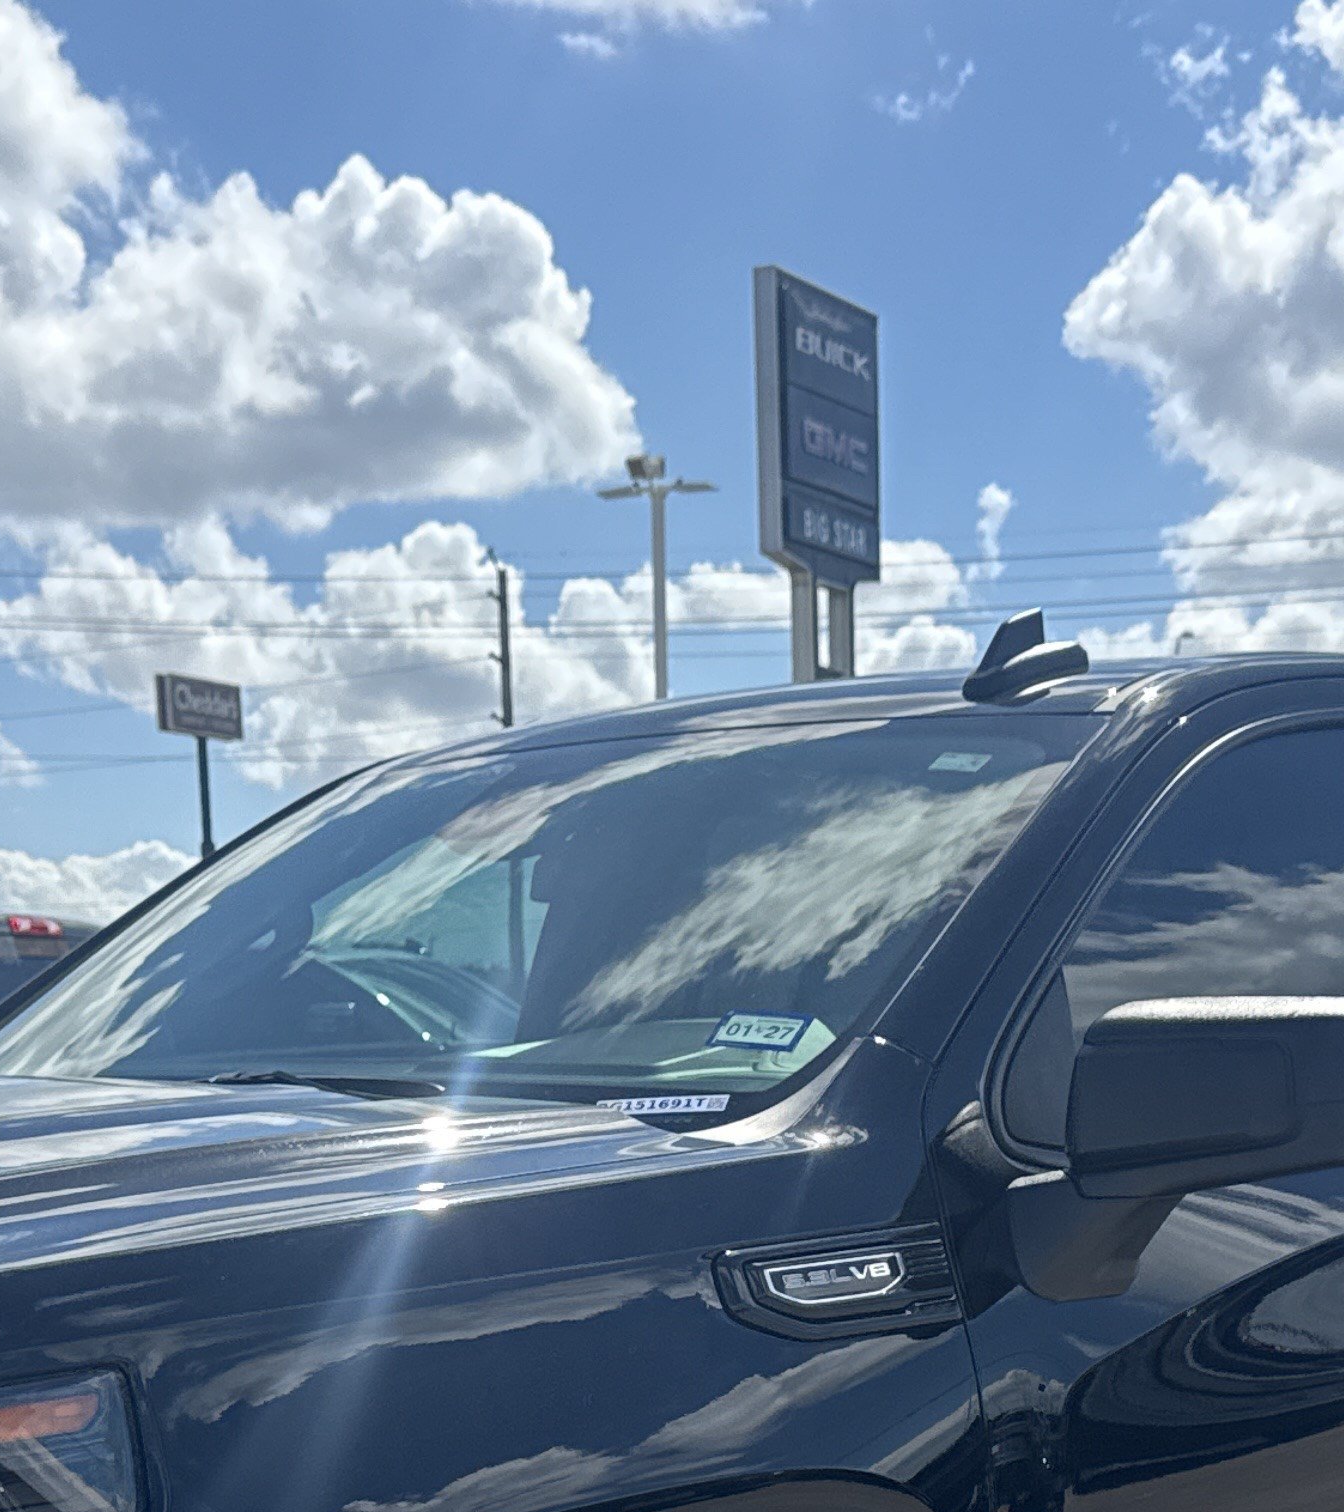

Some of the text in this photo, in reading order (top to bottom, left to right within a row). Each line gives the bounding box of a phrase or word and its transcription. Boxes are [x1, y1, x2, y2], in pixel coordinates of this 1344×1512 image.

[795, 326, 871, 381] BUICK
[802, 418, 868, 475] GMC
[802, 507, 830, 544] BIG
